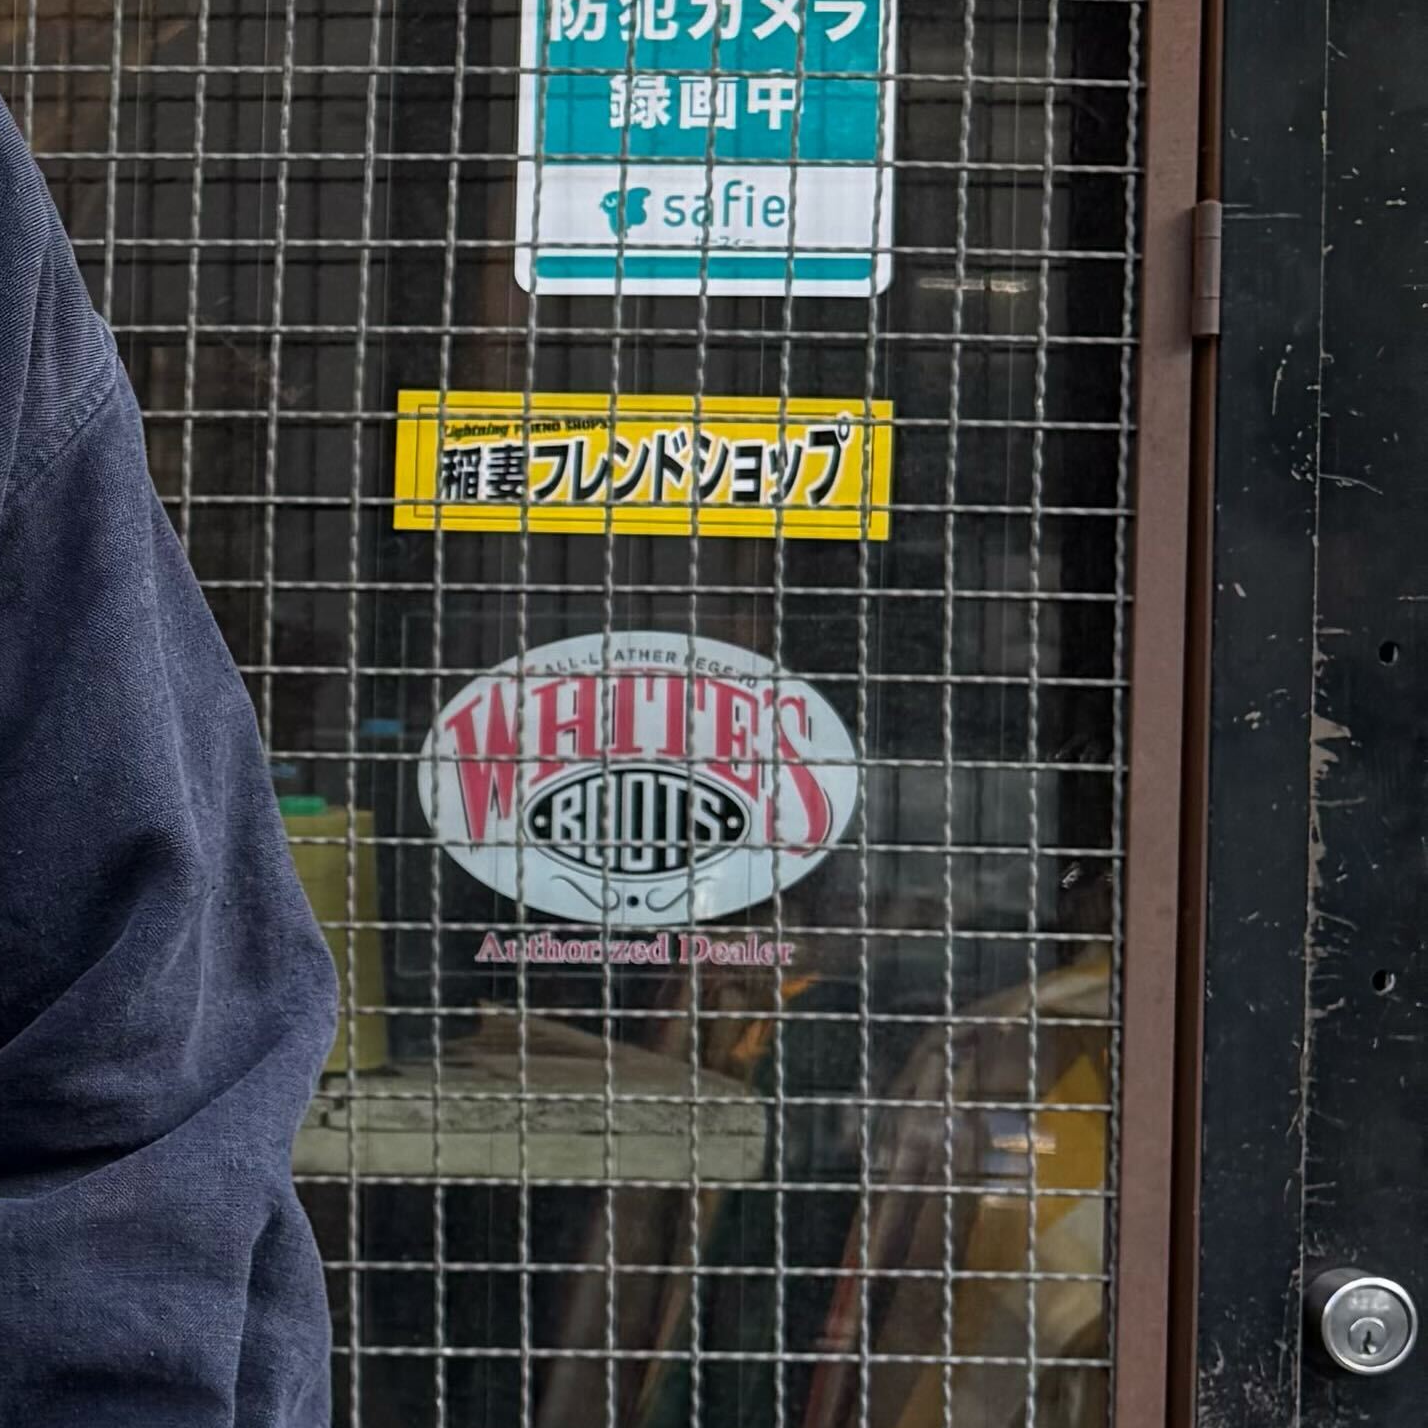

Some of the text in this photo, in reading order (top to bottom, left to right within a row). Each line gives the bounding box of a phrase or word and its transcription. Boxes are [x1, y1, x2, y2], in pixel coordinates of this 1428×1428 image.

[608, 70, 804, 131] 録画中
[662, 178, 786, 231] safie
[514, 421, 562, 436] FIEND
[443, 412, 852, 506] 稲妻フレンドショップ
[545, 648, 759, 689] ALL-LATHER EGED
[550, 772, 724, 872] BOOTS
[474, 932, 795, 965] Authorzed Dealer
